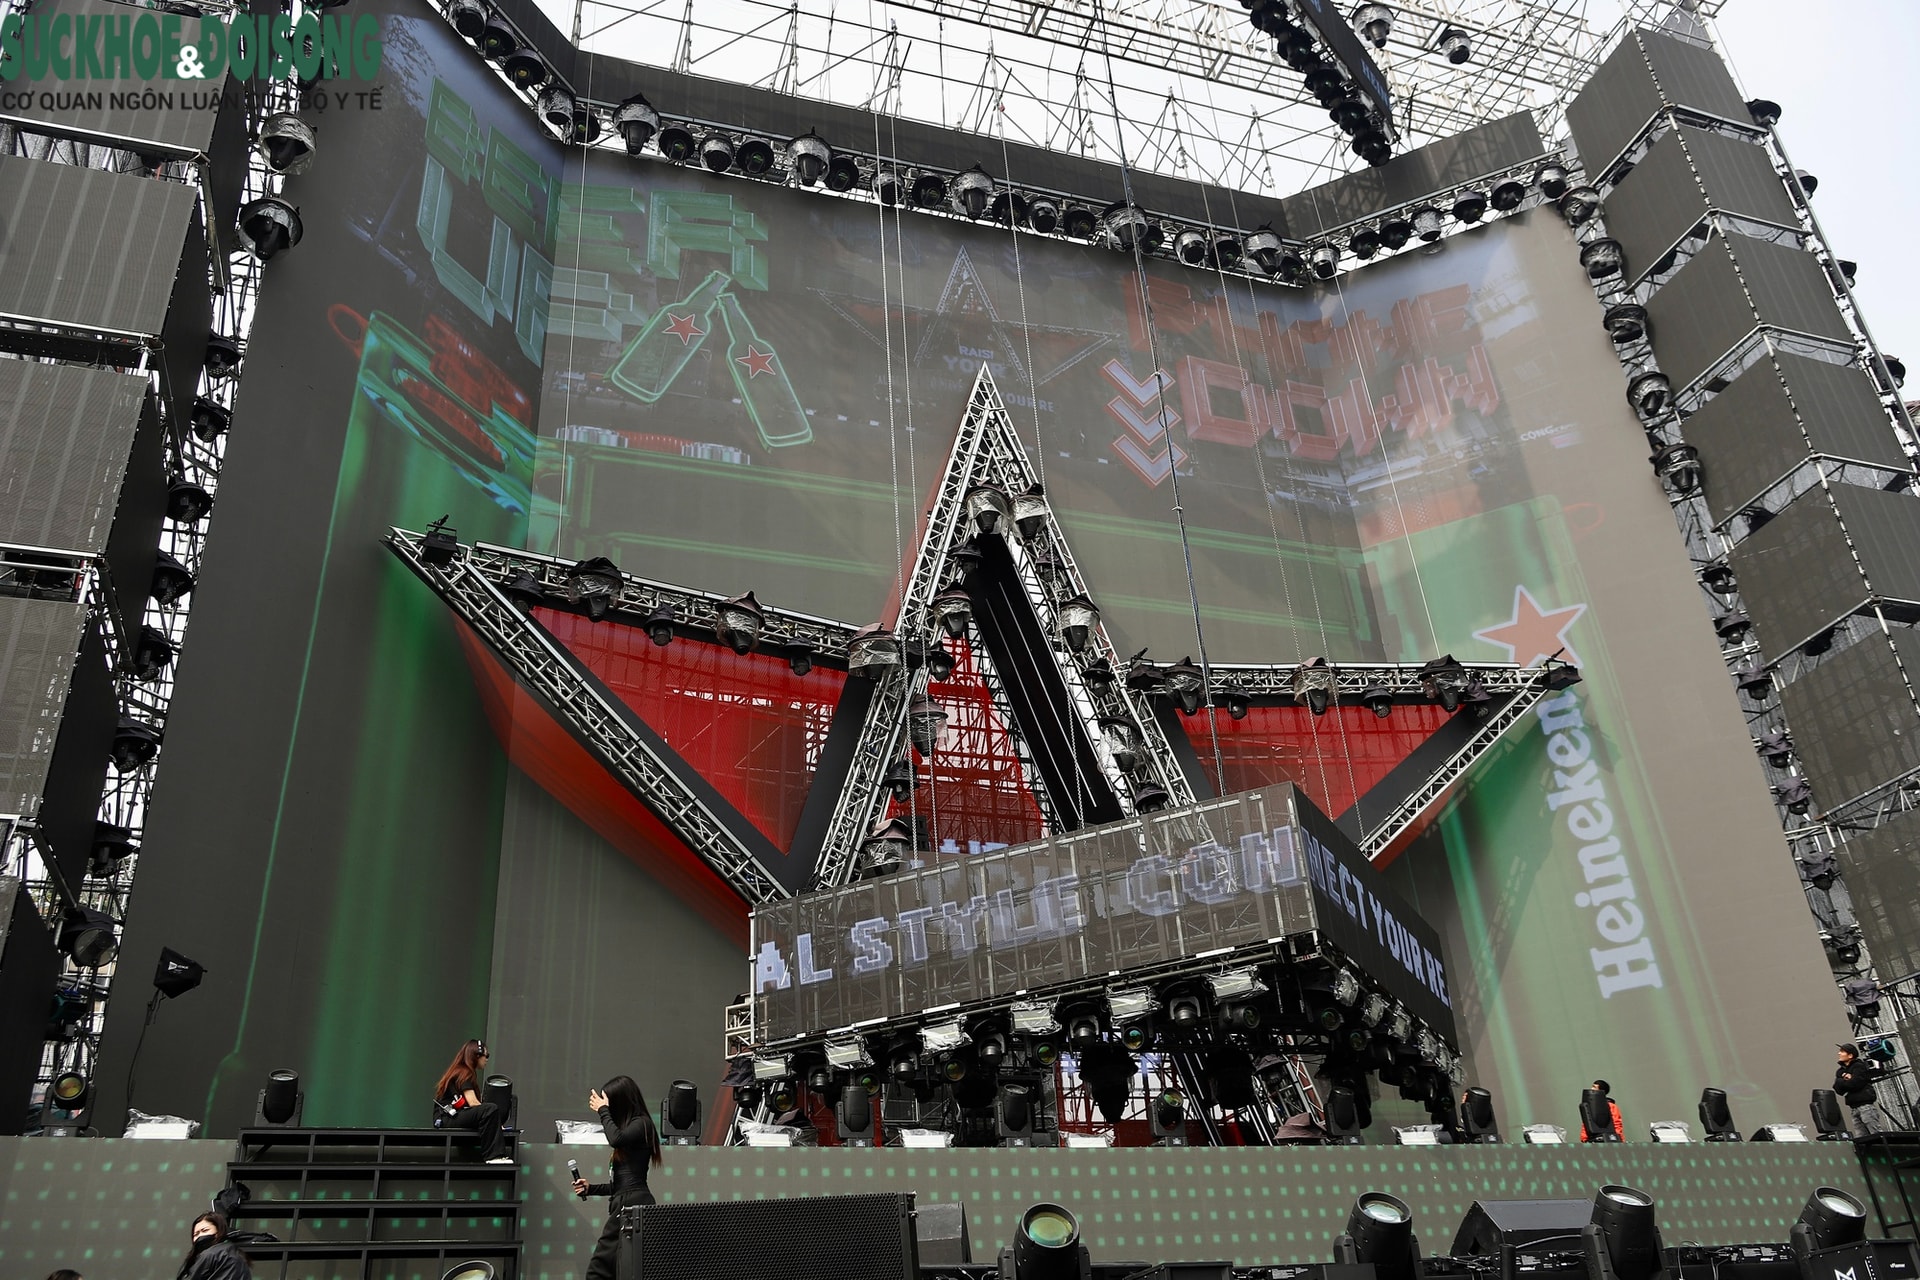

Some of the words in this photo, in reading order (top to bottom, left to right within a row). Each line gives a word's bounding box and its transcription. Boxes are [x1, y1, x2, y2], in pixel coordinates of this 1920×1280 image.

[1536, 690, 1662, 999] Heineken
[850, 874, 1085, 976] STYLE
[1367, 891, 1427, 986] YOUR
[1423, 946, 1453, 1010] RE
